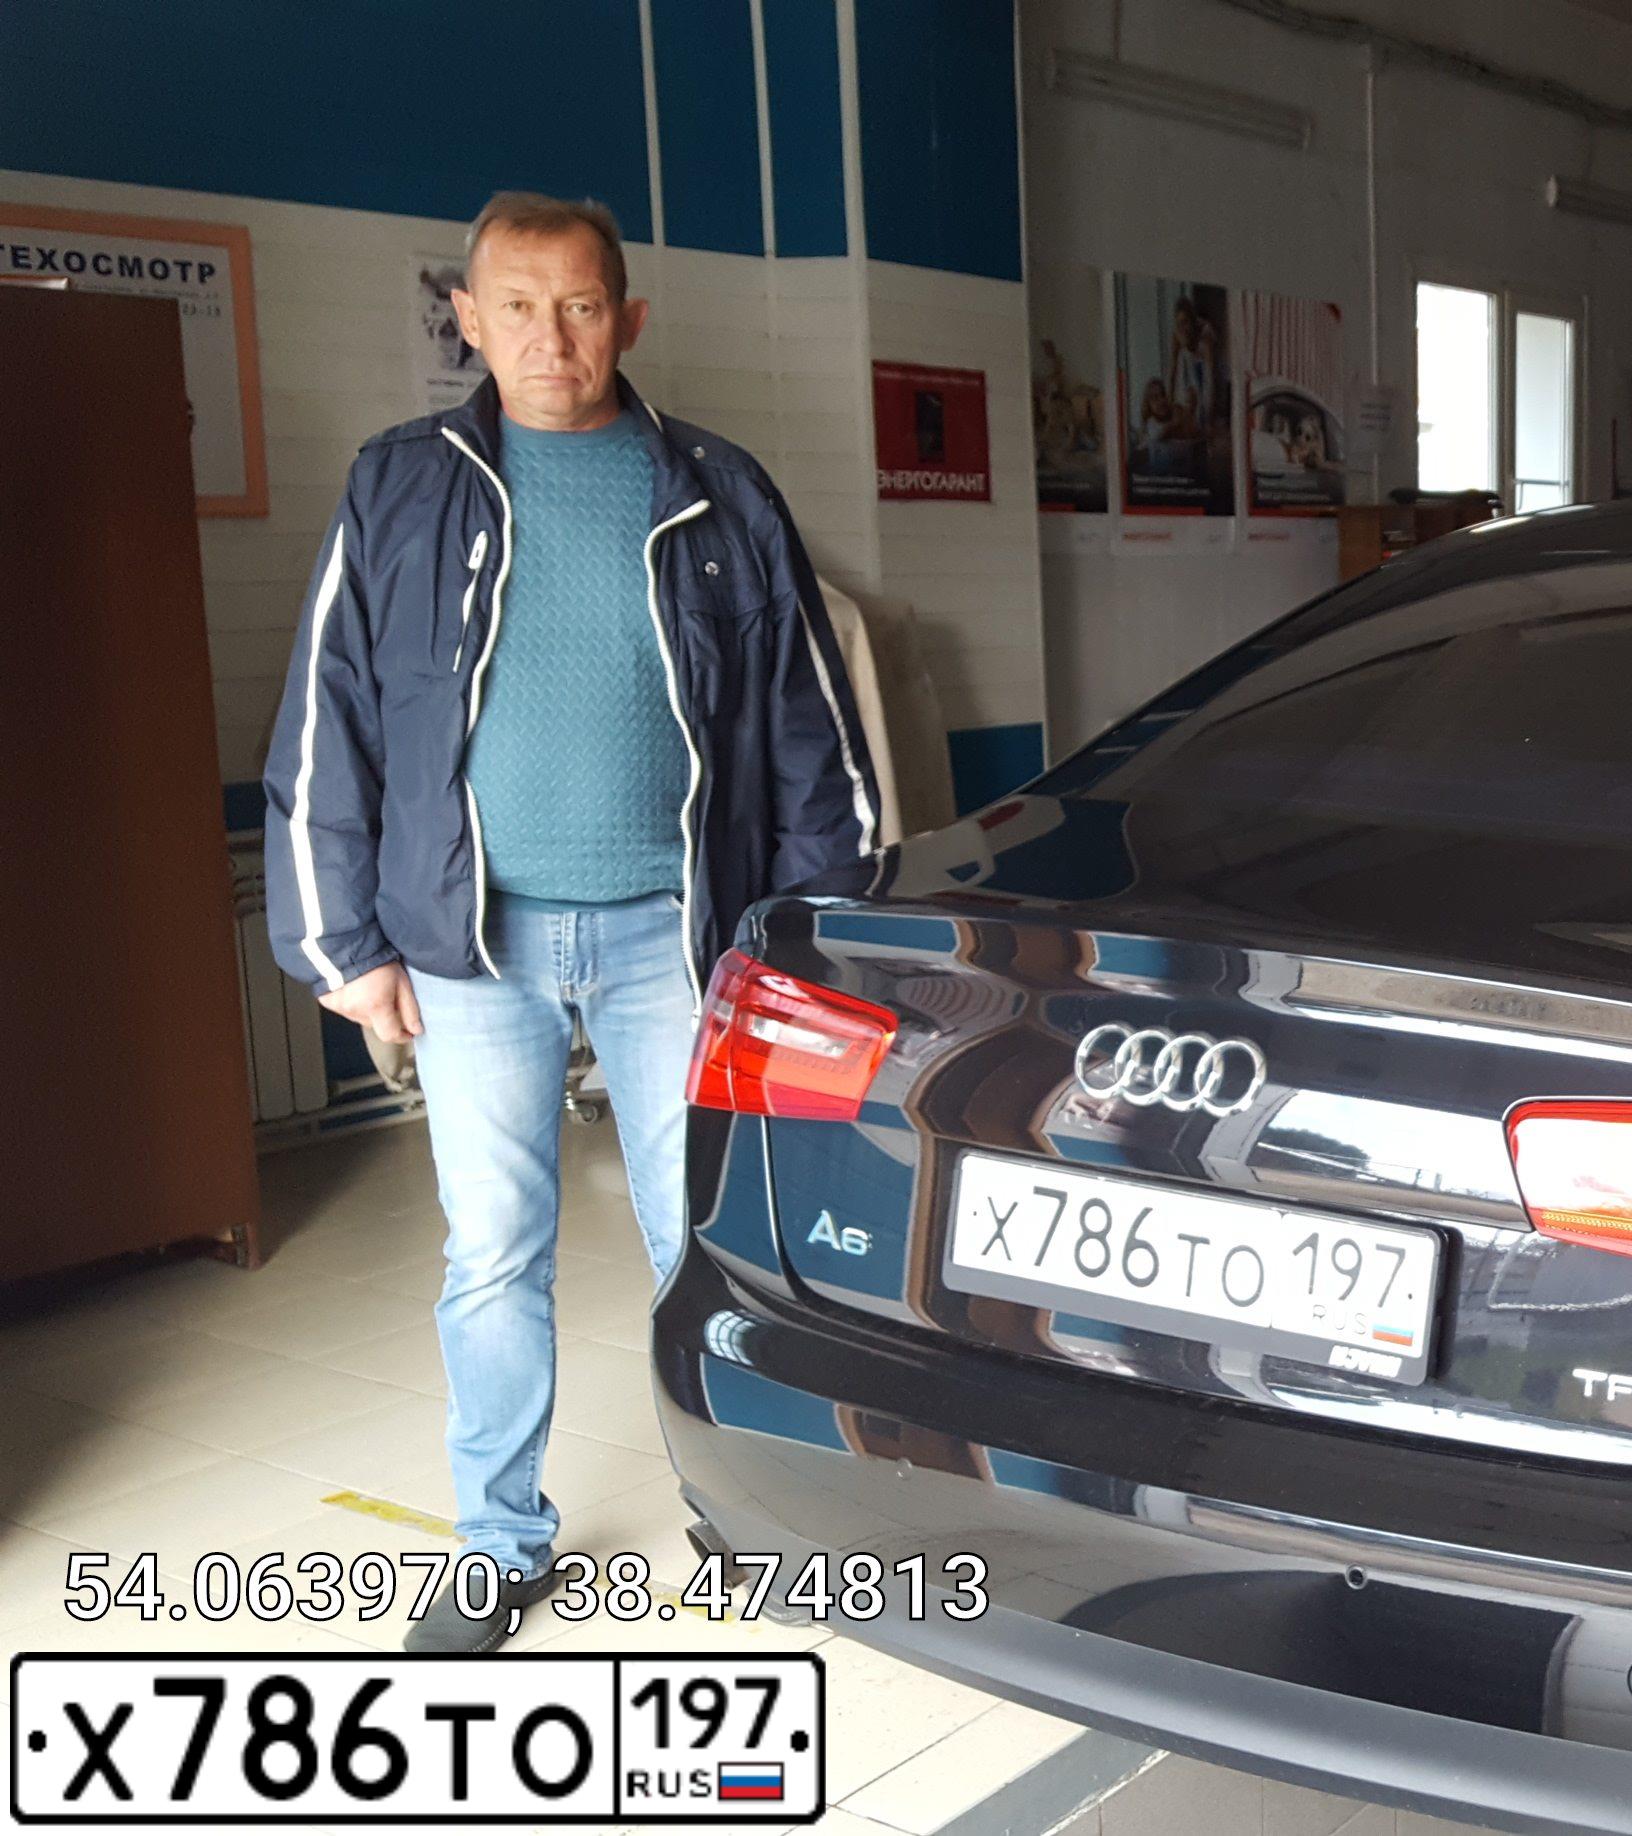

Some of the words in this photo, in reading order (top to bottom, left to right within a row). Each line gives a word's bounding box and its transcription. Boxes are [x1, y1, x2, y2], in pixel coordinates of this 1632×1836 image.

[0, 244, 216, 284] ЕХОСМОТР
[877, 469, 986, 492] ЭНЕРГОГАРАНТ
[807, 1209, 869, 1256] A6
[1292, 1232, 1407, 1308] 197
[1312, 1303, 1367, 1335] RUS
